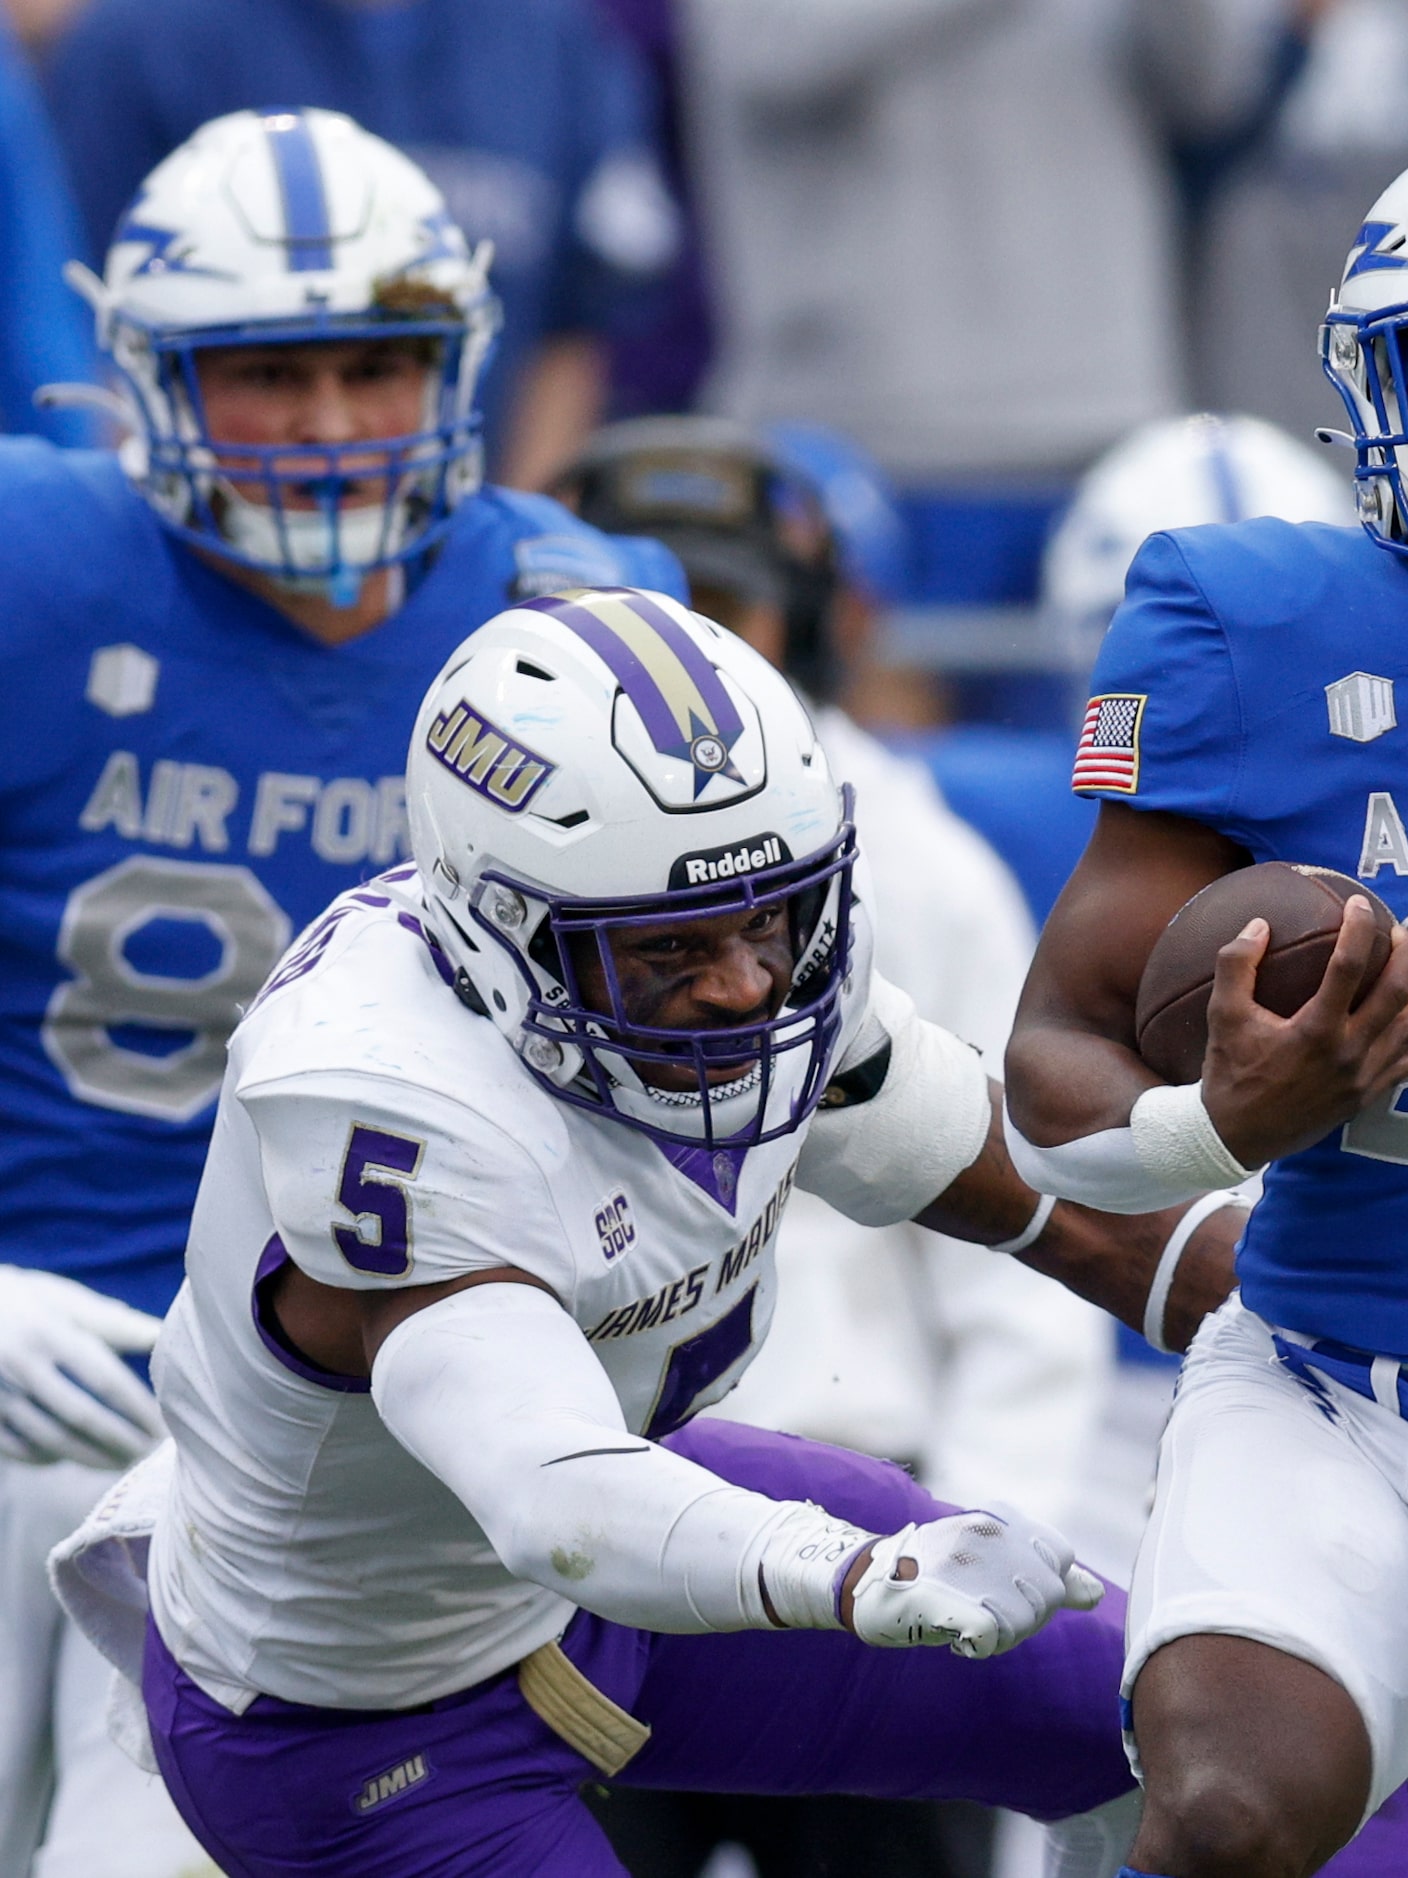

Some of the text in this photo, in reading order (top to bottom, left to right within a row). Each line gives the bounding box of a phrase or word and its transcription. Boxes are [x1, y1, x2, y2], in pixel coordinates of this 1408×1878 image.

[78, 750, 239, 852] AIR
[427, 703, 550, 812] JMU
[685, 837, 782, 883] Riddell
[40, 853, 292, 1124] 8
[330, 1119, 428, 1280] 5
[582, 1261, 712, 1341] JAMES
[360, 1754, 426, 1809] JMU
